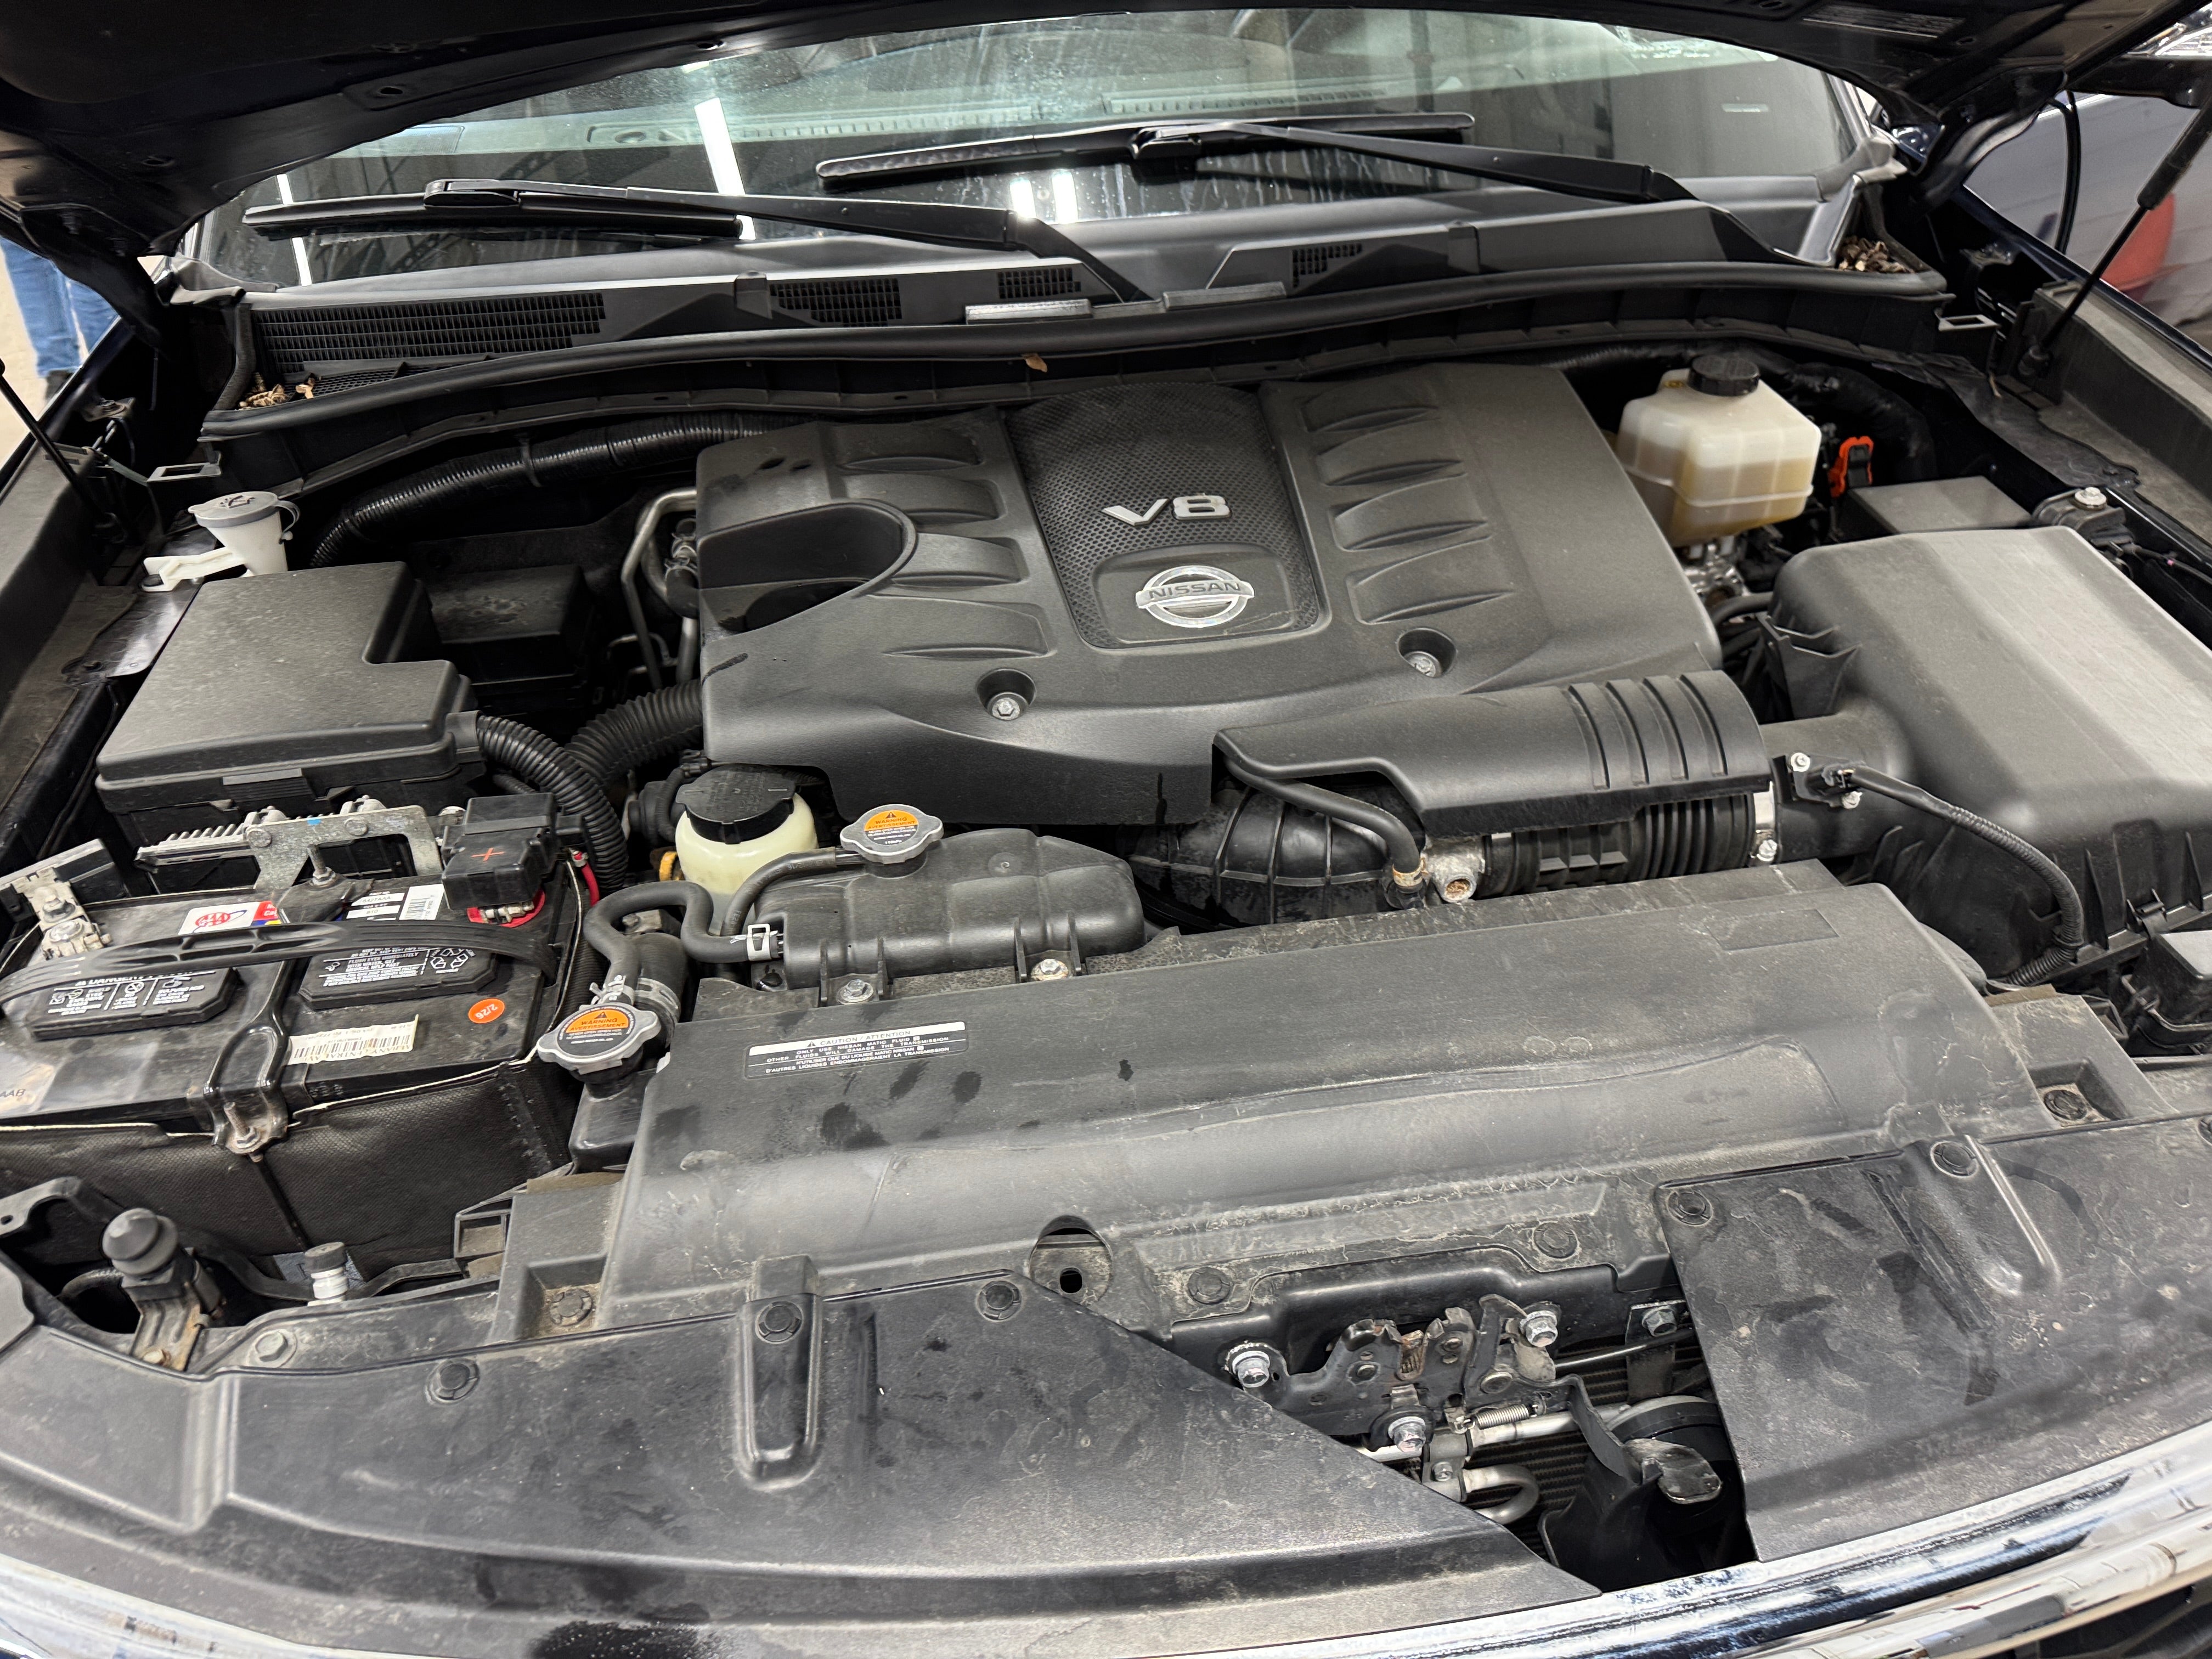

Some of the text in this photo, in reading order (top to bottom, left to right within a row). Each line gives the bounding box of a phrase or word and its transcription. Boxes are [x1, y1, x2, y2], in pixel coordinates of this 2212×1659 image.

[1101, 494, 1232, 526] V8
[1149, 582, 1241, 599] NISSAN
[868, 821, 915, 829] AVERTISSEMENT
[196, 912, 230, 927] AAA
[475, 1003, 498, 1019] 2/26
[820, 1037, 857, 1046] CAUTION
[866, 1031, 911, 1040] ATTENTION
[900, 1037, 949, 1046] TRANSMISSION
[765, 1065, 796, 1074] D'AUTRES
[905, 1047, 950, 1056] TRANSMISSION
